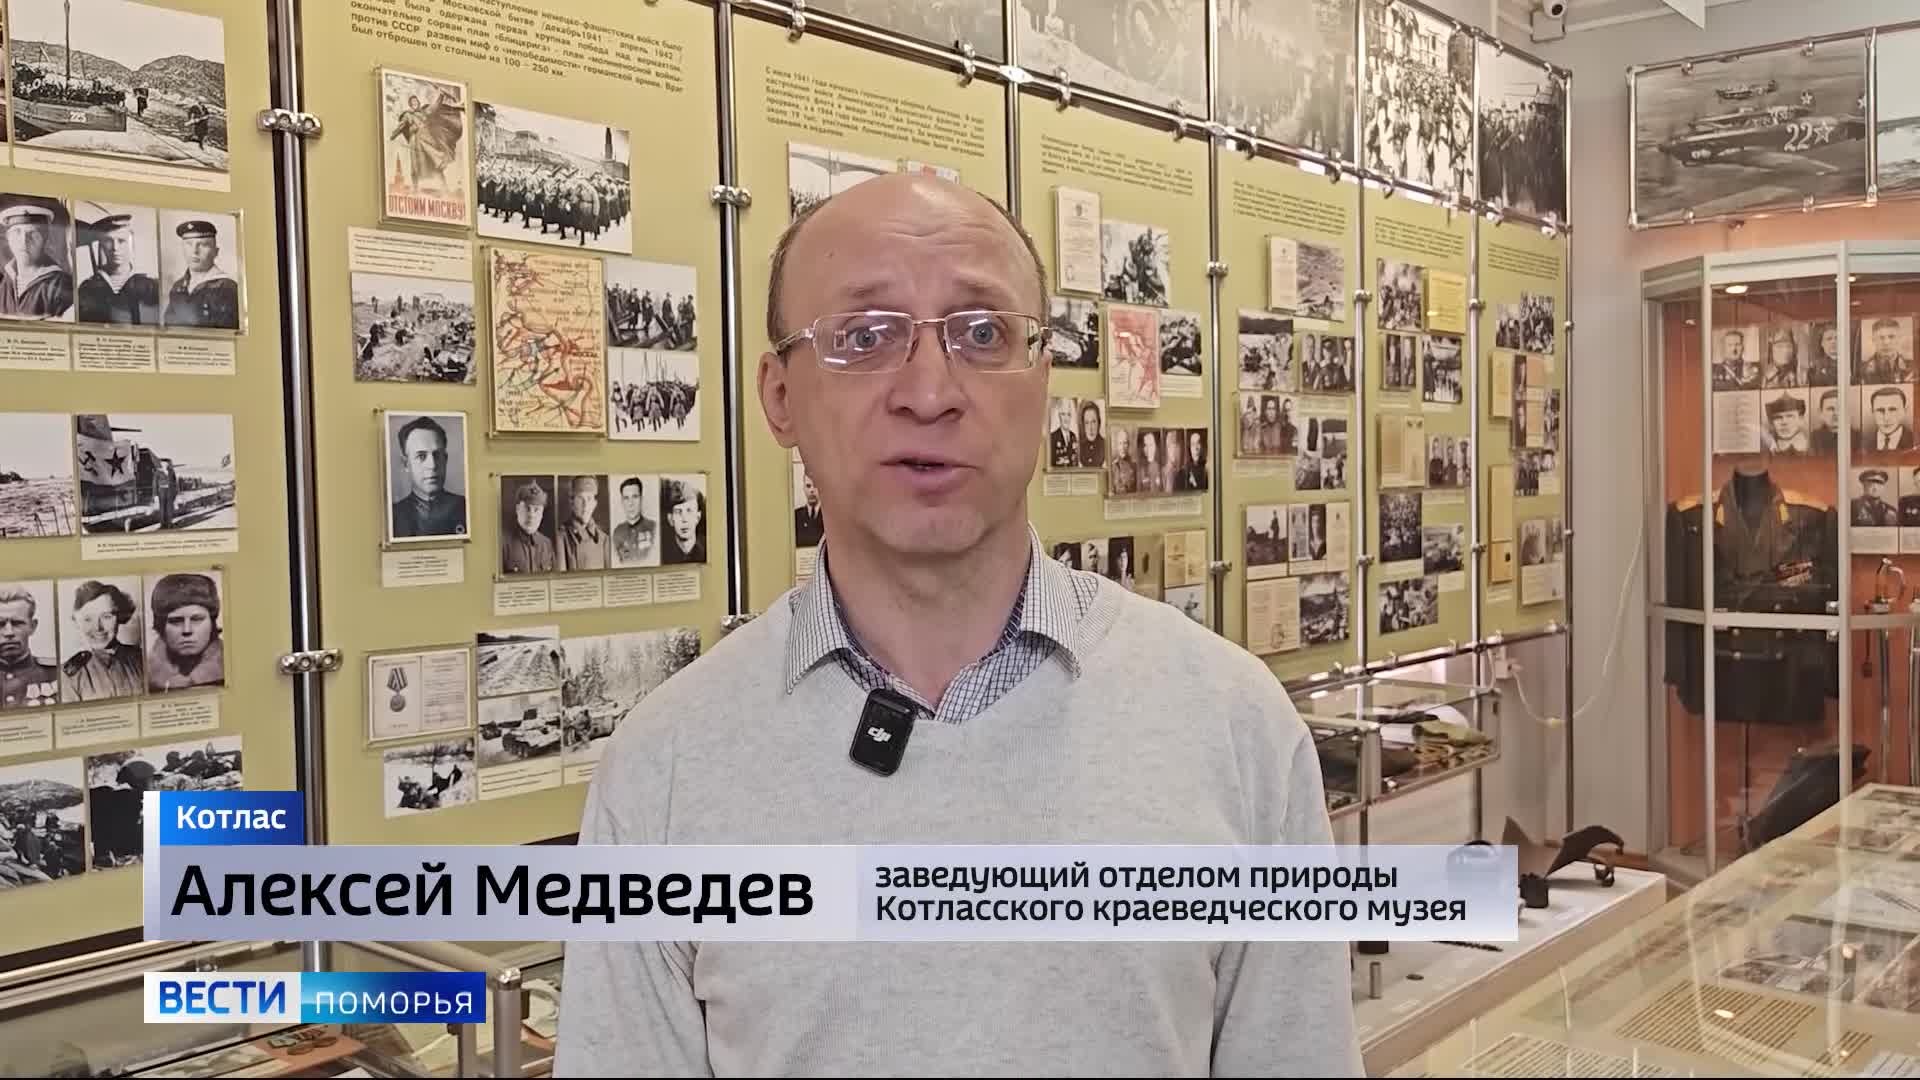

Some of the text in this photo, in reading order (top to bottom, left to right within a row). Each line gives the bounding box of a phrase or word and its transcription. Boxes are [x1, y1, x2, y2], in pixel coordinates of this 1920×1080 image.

[350, 0, 423, 24] окончательно
[427, 18, 463, 33] сорван
[467, 28, 491, 38] план
[562, 49, 586, 61] план
[405, 0, 431, 13] была
[439, 9, 488, 27] одержана
[494, 23, 529, 37] первая
[535, 32, 571, 46] крупная
[577, 41, 609, 56] победа
[615, 50, 632, 62] над
[442, 0, 502, 18] Московской
[508, 12, 535, 27] битве
[351, 13, 389, 28] против
[426, 29, 468, 45] развеян
[468, 39, 491, 53] миф
[583, 64, 633, 82] германской
[351, 23, 374, 36] был
[375, 29, 429, 48] отброшен
[430, 41, 443, 51] от
[444, 45, 488, 61] столицы
[489, 55, 502, 64] на
[504, 56, 521, 69] 100
[532, 62, 550, 74] 250
[1784, 122, 1812, 151] 22
[387, 194, 466, 221] ОТСТОИМ МОСКВУ!
